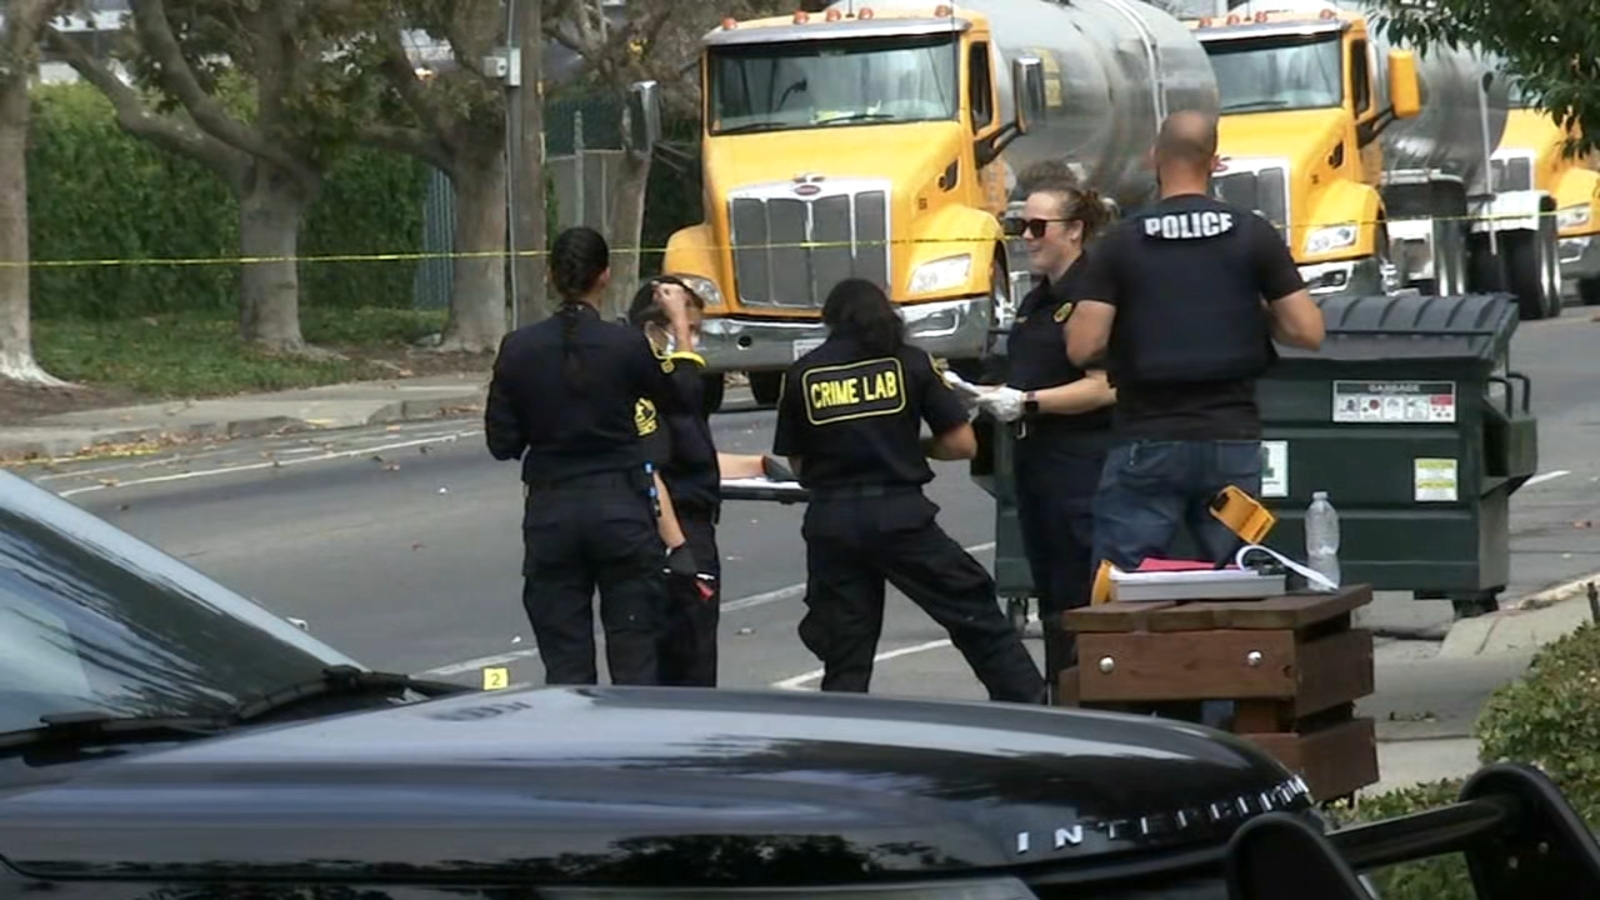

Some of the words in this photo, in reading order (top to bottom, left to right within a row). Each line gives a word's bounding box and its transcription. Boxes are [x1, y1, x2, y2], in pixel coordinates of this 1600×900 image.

[1144, 211, 1234, 239] POLICE
[810, 378, 860, 409] CRIME
[863, 371, 898, 401] LAB
[490, 672, 501, 686] 2
